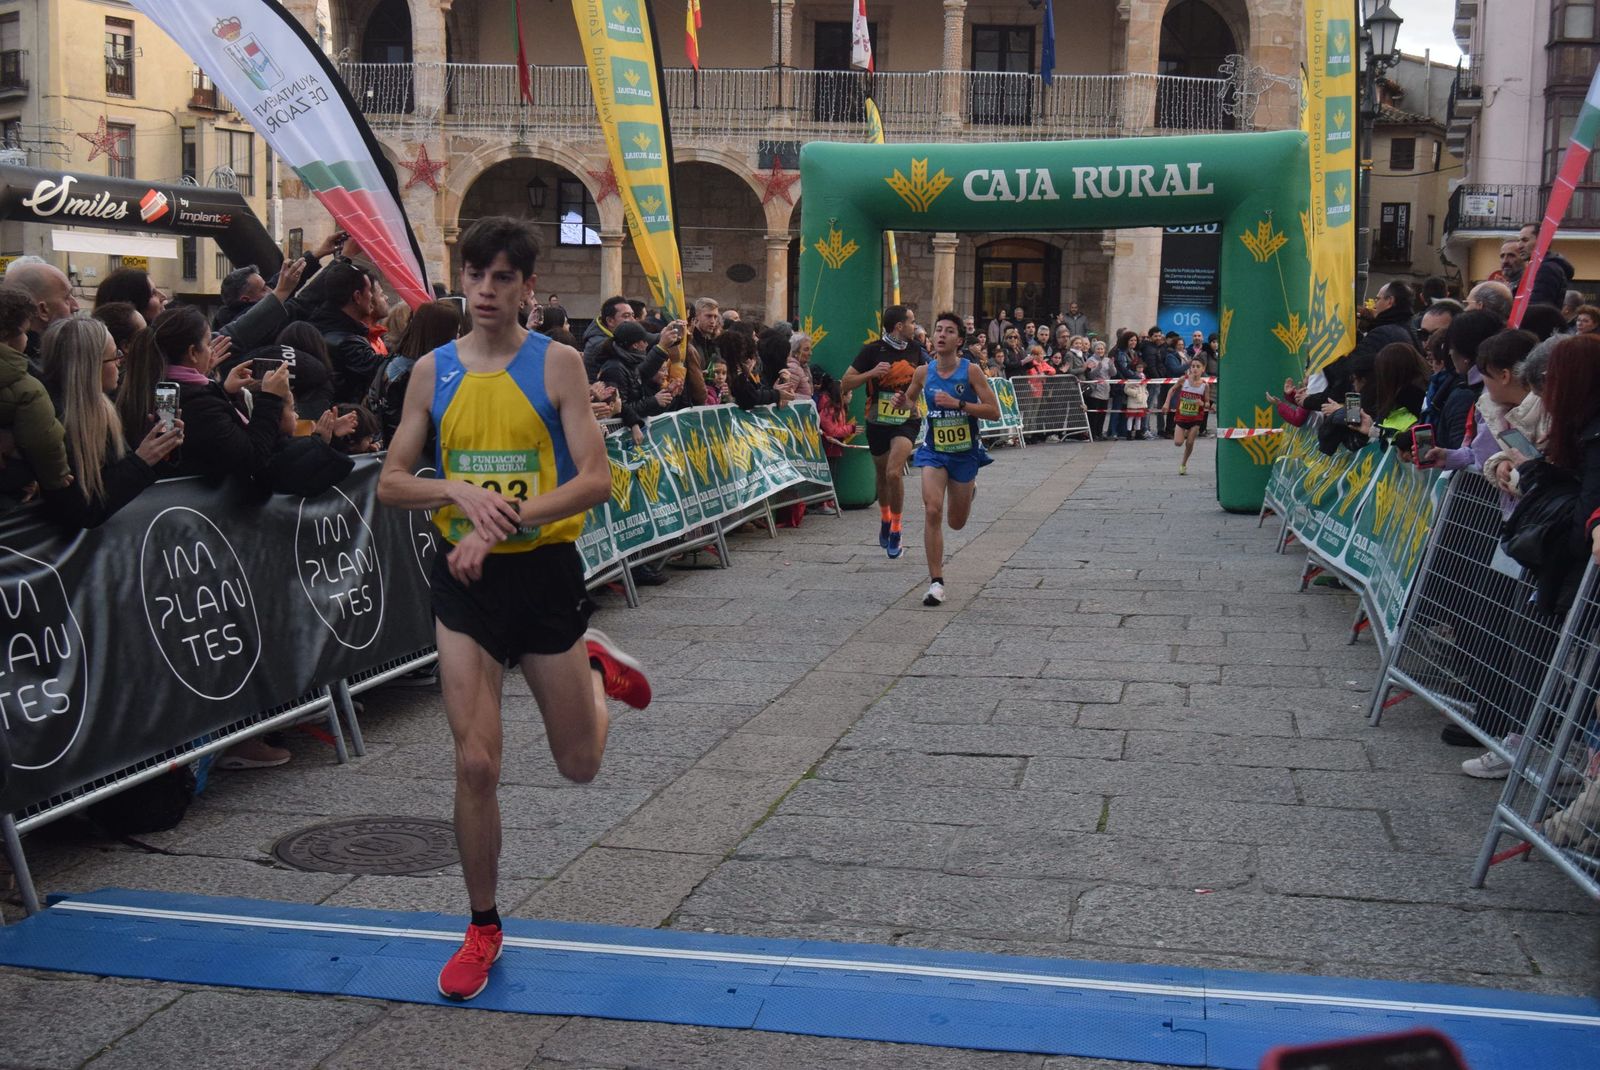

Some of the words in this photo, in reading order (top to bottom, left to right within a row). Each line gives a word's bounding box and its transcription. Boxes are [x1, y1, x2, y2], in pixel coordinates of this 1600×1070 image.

[22, 175, 129, 220] Smiles
[963, 168, 1060, 202] CAJA
[1072, 163, 1214, 198] RURAL
[180, 197, 189, 208] by
[1173, 313, 1201, 327] 016
[937, 427, 966, 444] 909
[472, 464, 494, 473] CAJA
[496, 463, 527, 472] RURAL
[314, 513, 351, 545] IM
[163, 541, 217, 579] IM
[329, 584, 374, 619] TES
[182, 623, 244, 667] TES
